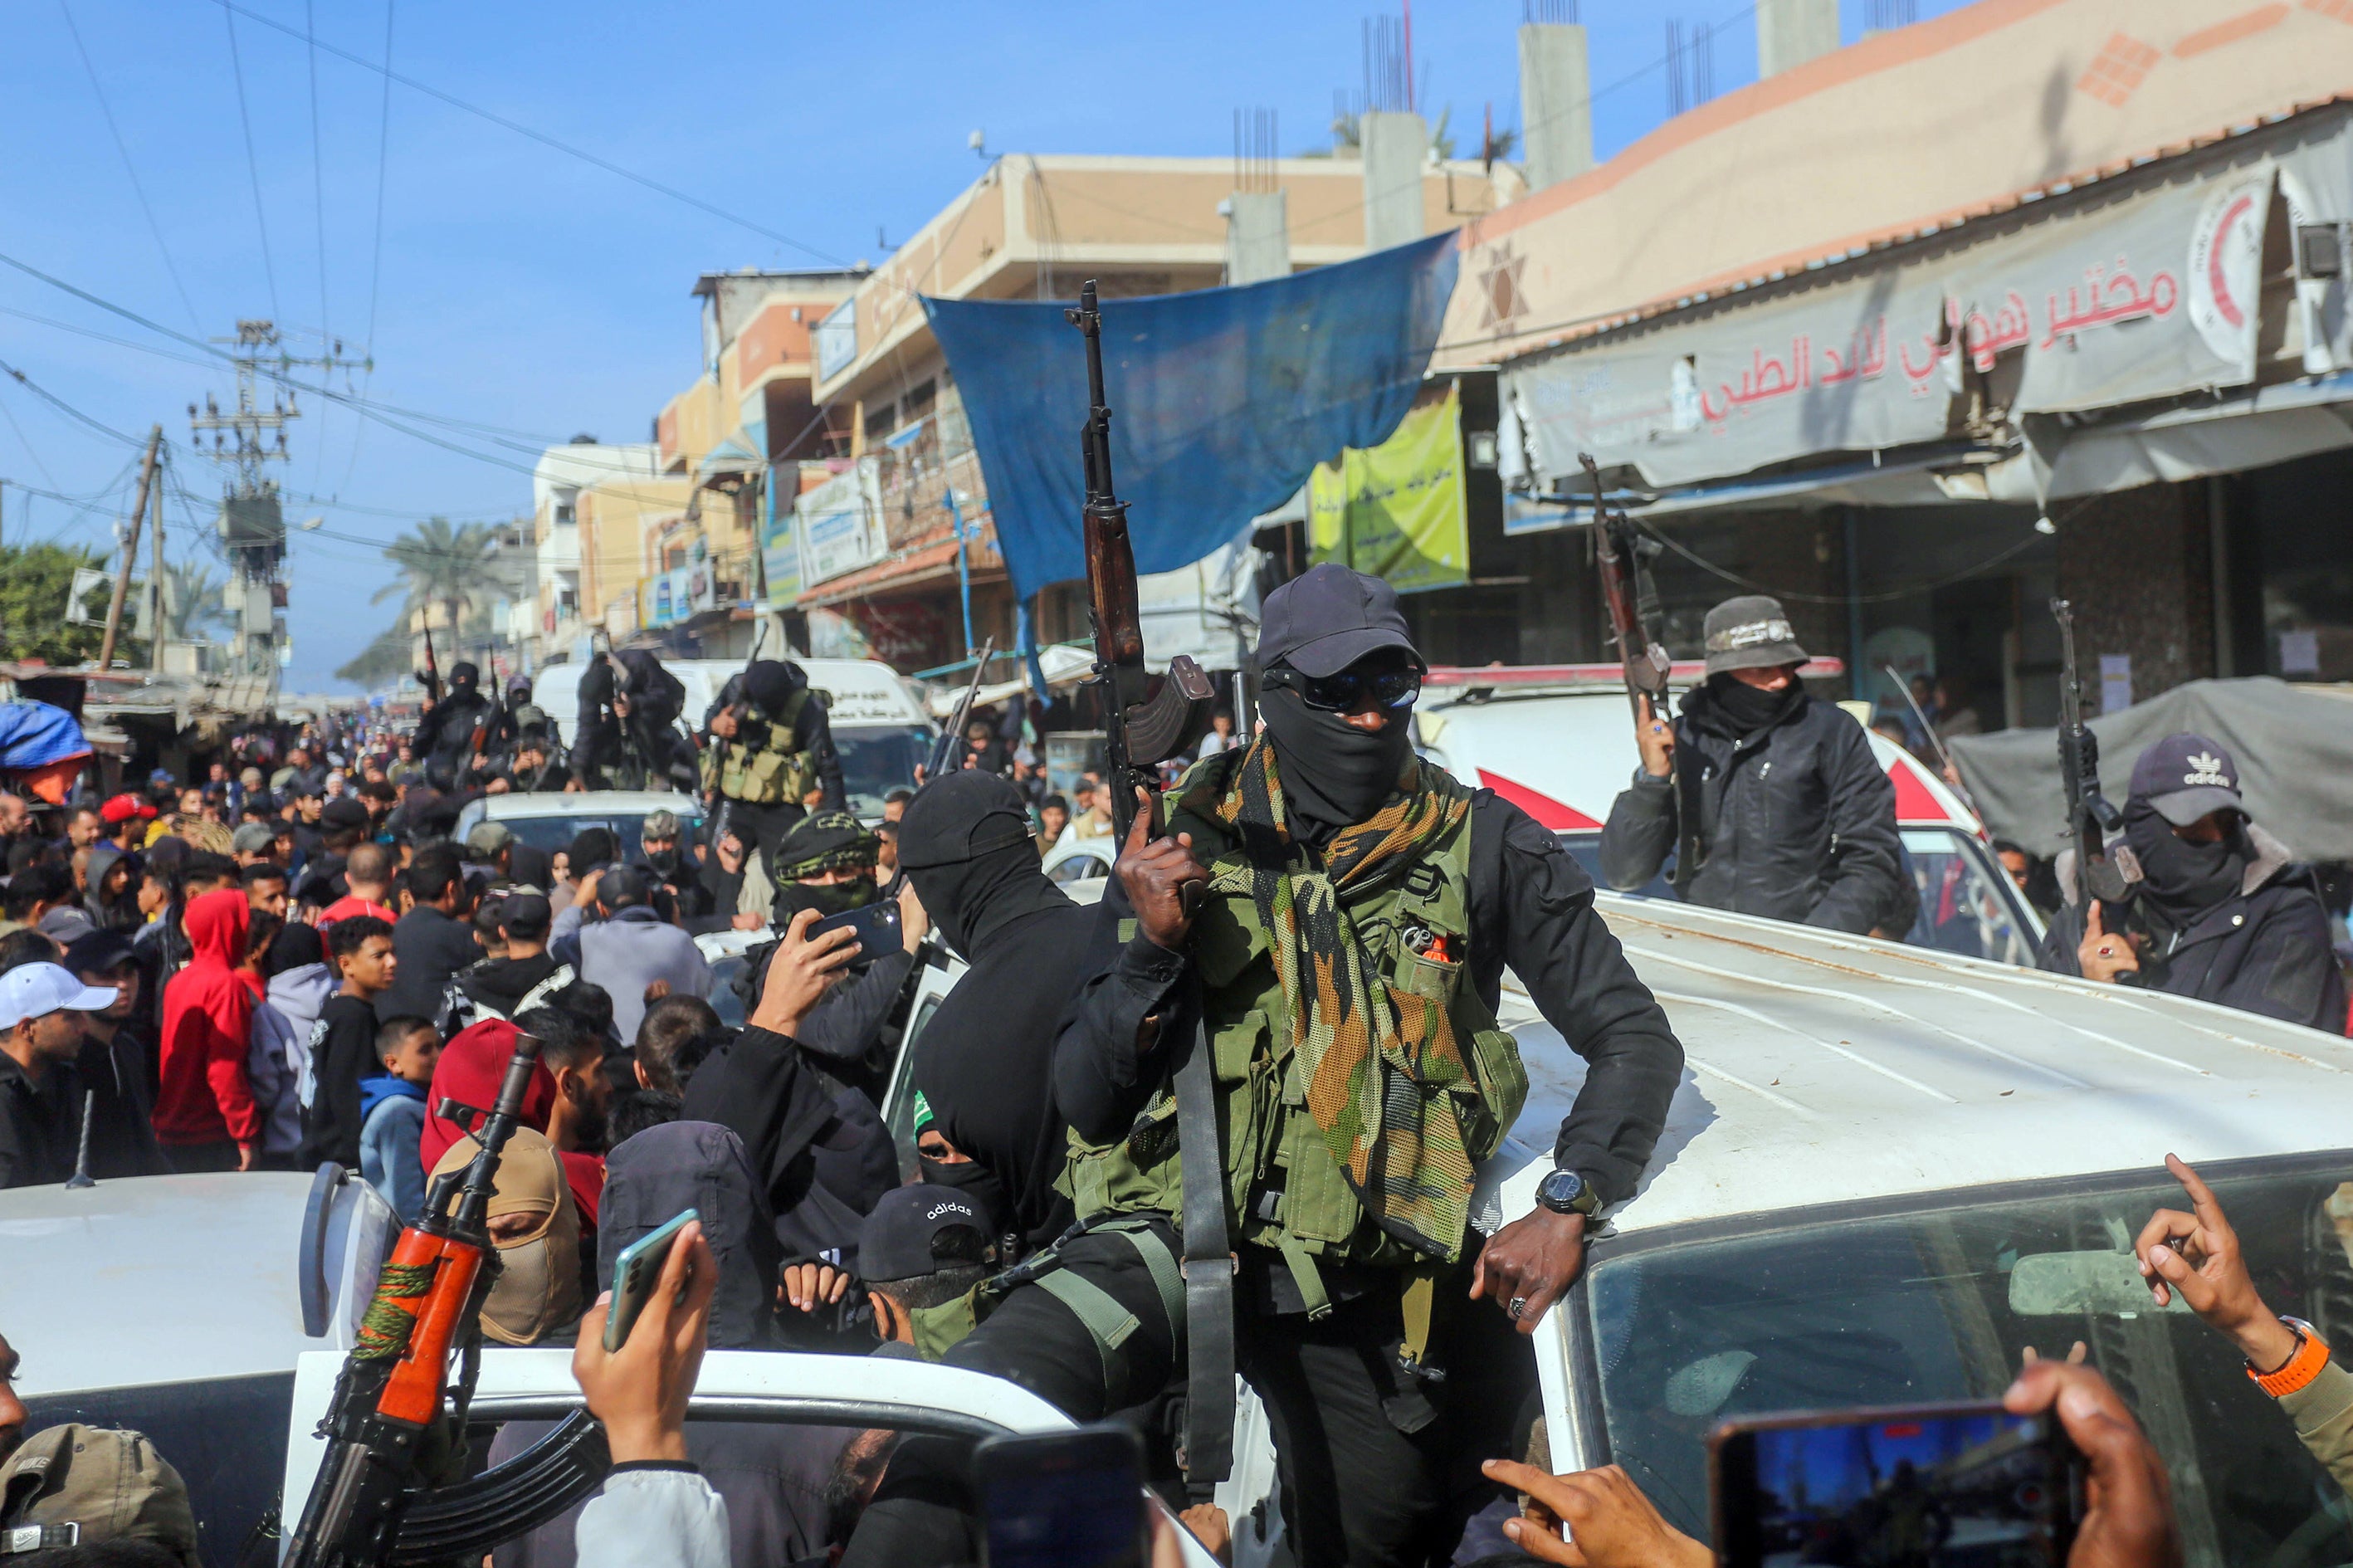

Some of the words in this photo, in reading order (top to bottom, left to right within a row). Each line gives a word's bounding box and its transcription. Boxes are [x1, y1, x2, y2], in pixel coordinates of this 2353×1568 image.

[2039, 256, 2178, 359] مختبر
[1821, 314, 1887, 384] لاند
[1700, 335, 1811, 435] الطبي
[2184, 773, 2230, 787] adidas
[926, 1201, 972, 1220] adidas
[15, 1457, 51, 1473] NIKE
